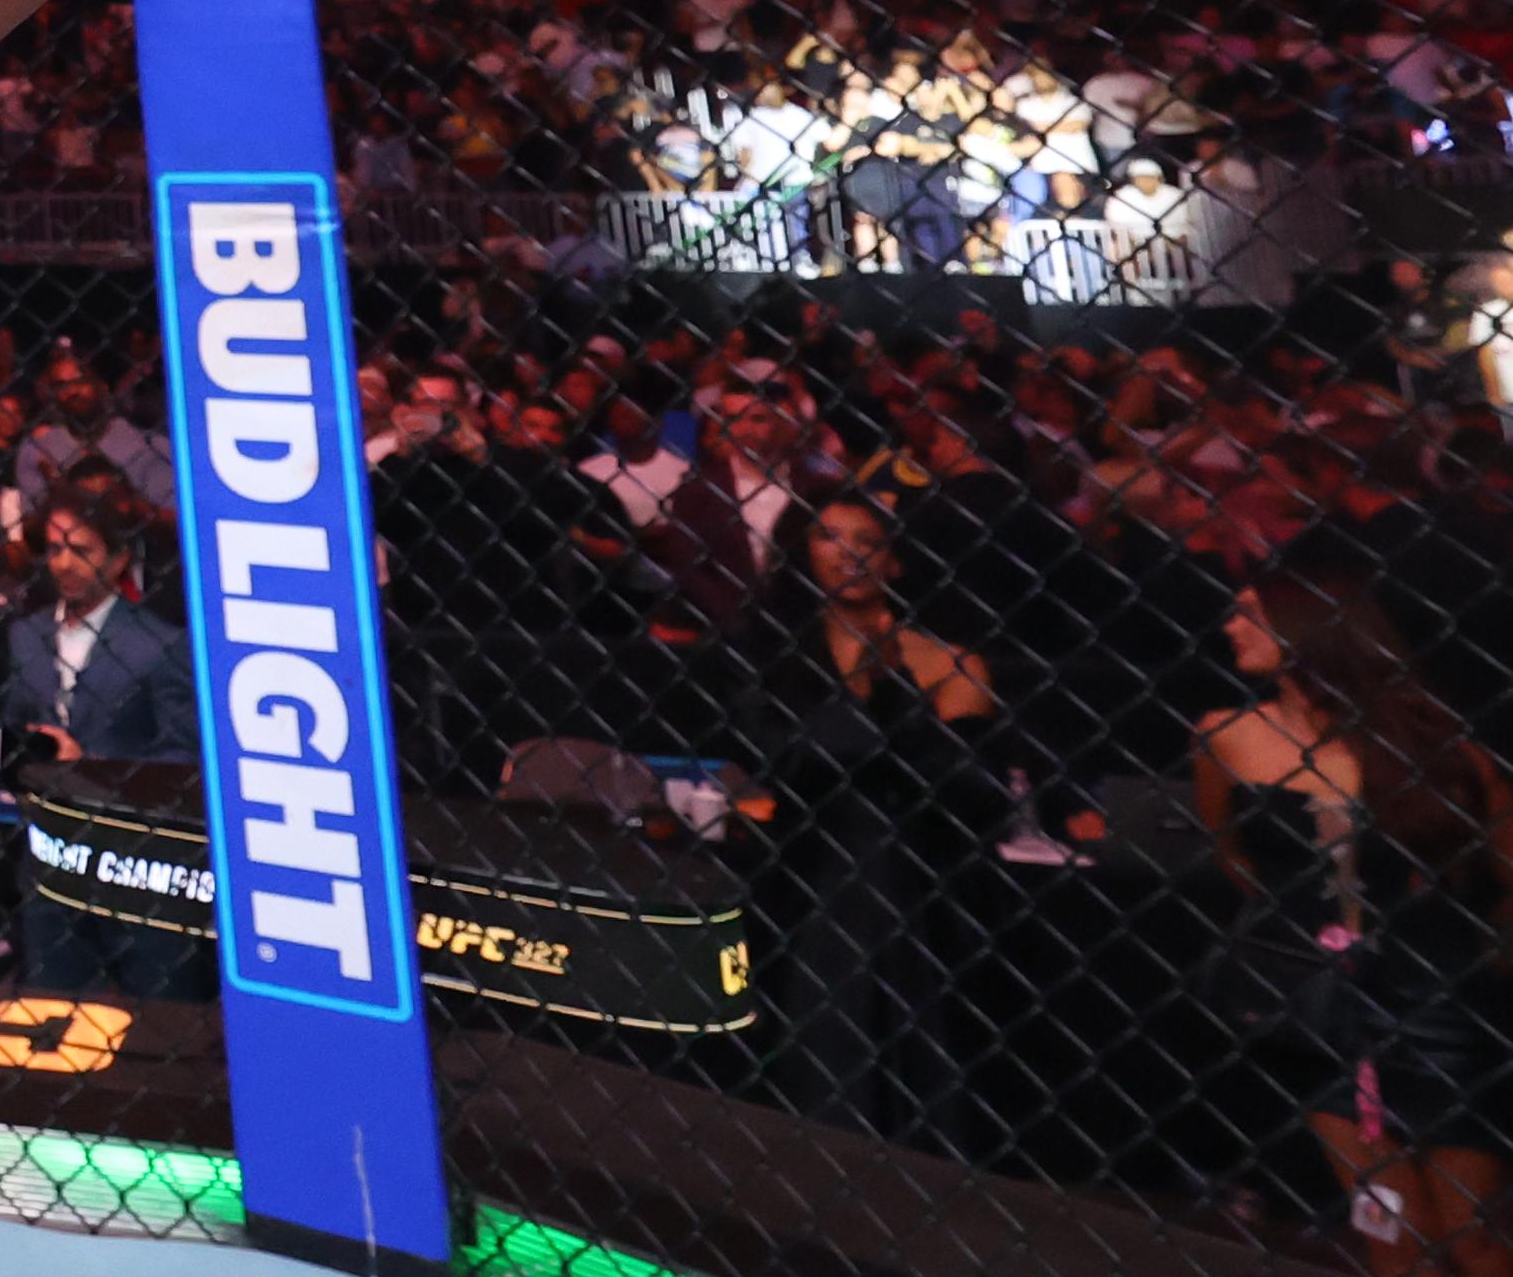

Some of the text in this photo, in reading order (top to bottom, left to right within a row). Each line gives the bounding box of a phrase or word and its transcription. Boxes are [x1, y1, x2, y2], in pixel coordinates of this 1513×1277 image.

[187, 201, 373, 981] BUD LIGHT
[416, 913, 515, 962] UFC
